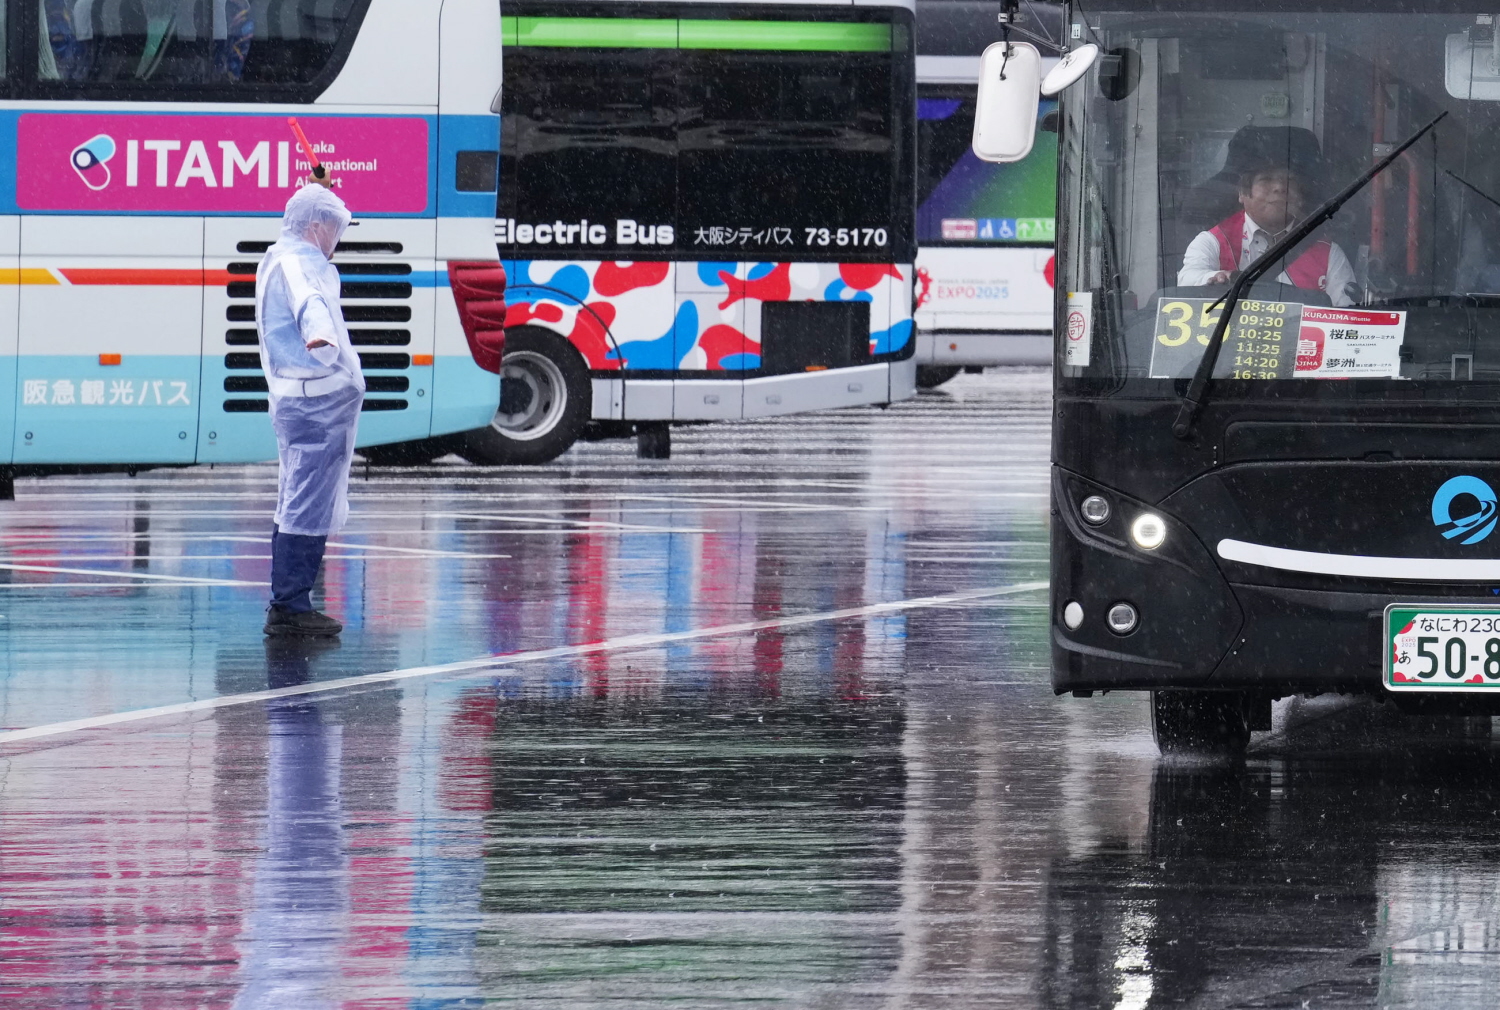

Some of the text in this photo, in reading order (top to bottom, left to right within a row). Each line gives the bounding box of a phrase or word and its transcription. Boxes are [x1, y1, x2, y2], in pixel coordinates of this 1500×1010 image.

[295, 141, 336, 153] Oaka
[126, 140, 290, 188] ITAMI
[295, 159, 378, 171] Intrnational
[494, 219, 674, 245] Electric Bus
[694, 226, 888, 246] 大阪シティバス 73-5170
[938, 286, 1009, 299] EXPO2025
[1241, 301, 1286, 314] 08:40
[1239, 314, 1284, 328] 09:30
[1302, 311, 1349, 321] KURAJIMA
[1157, 301, 1231, 347] 35
[1238, 328, 1282, 341] 10:25
[1329, 328, 1358, 340] 桜島
[1236, 342, 1280, 355] 11:25
[1235, 356, 1279, 368] 14:20
[1326, 358, 1355, 369] 夢洲
[1233, 370, 1278, 380] 16:30
[23, 379, 191, 406] 阪急観光バス
[1398, 650, 1411, 665] あ
